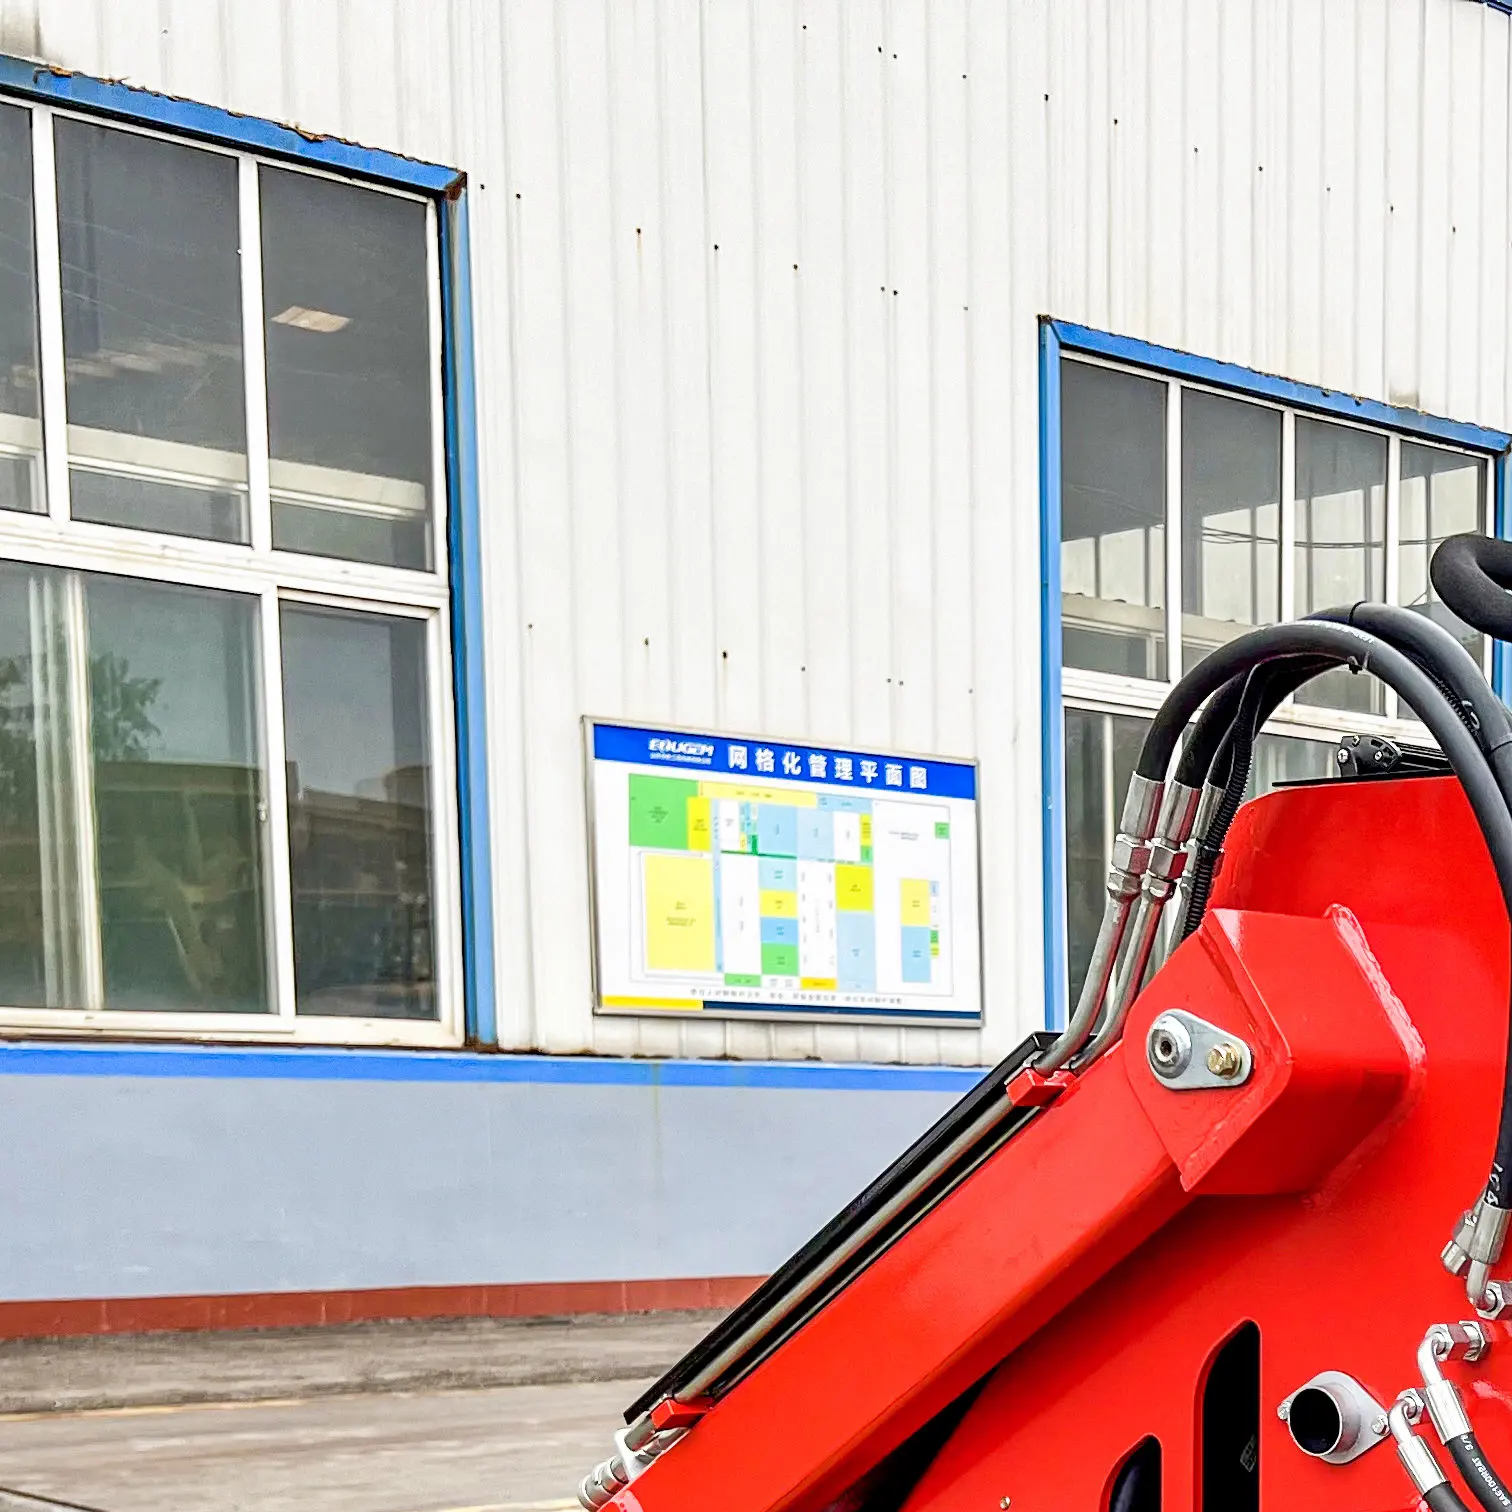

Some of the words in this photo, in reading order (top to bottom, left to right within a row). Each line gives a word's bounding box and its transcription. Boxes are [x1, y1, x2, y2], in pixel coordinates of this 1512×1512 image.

[727, 744, 928, 790] 网格化管理平面图
